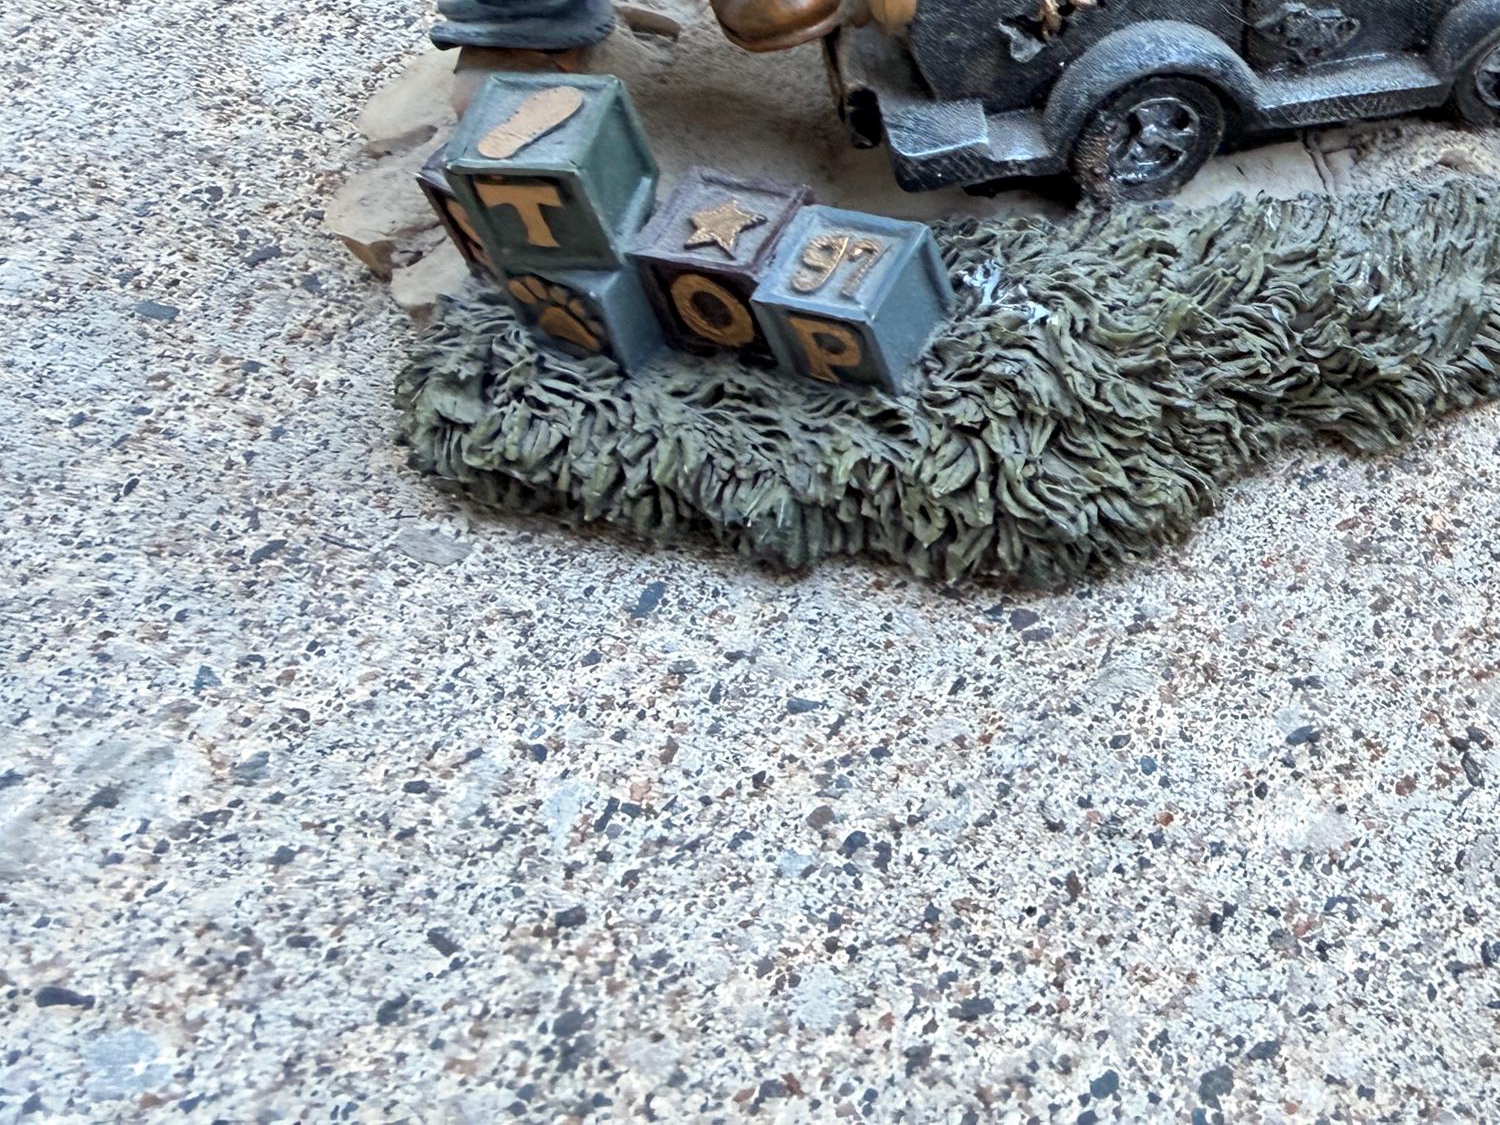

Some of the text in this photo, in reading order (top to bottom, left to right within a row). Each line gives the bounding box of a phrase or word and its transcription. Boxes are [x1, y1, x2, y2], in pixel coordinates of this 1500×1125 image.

[473, 179, 564, 248] T
[670, 274, 755, 347] O
[788, 314, 863, 384] P
